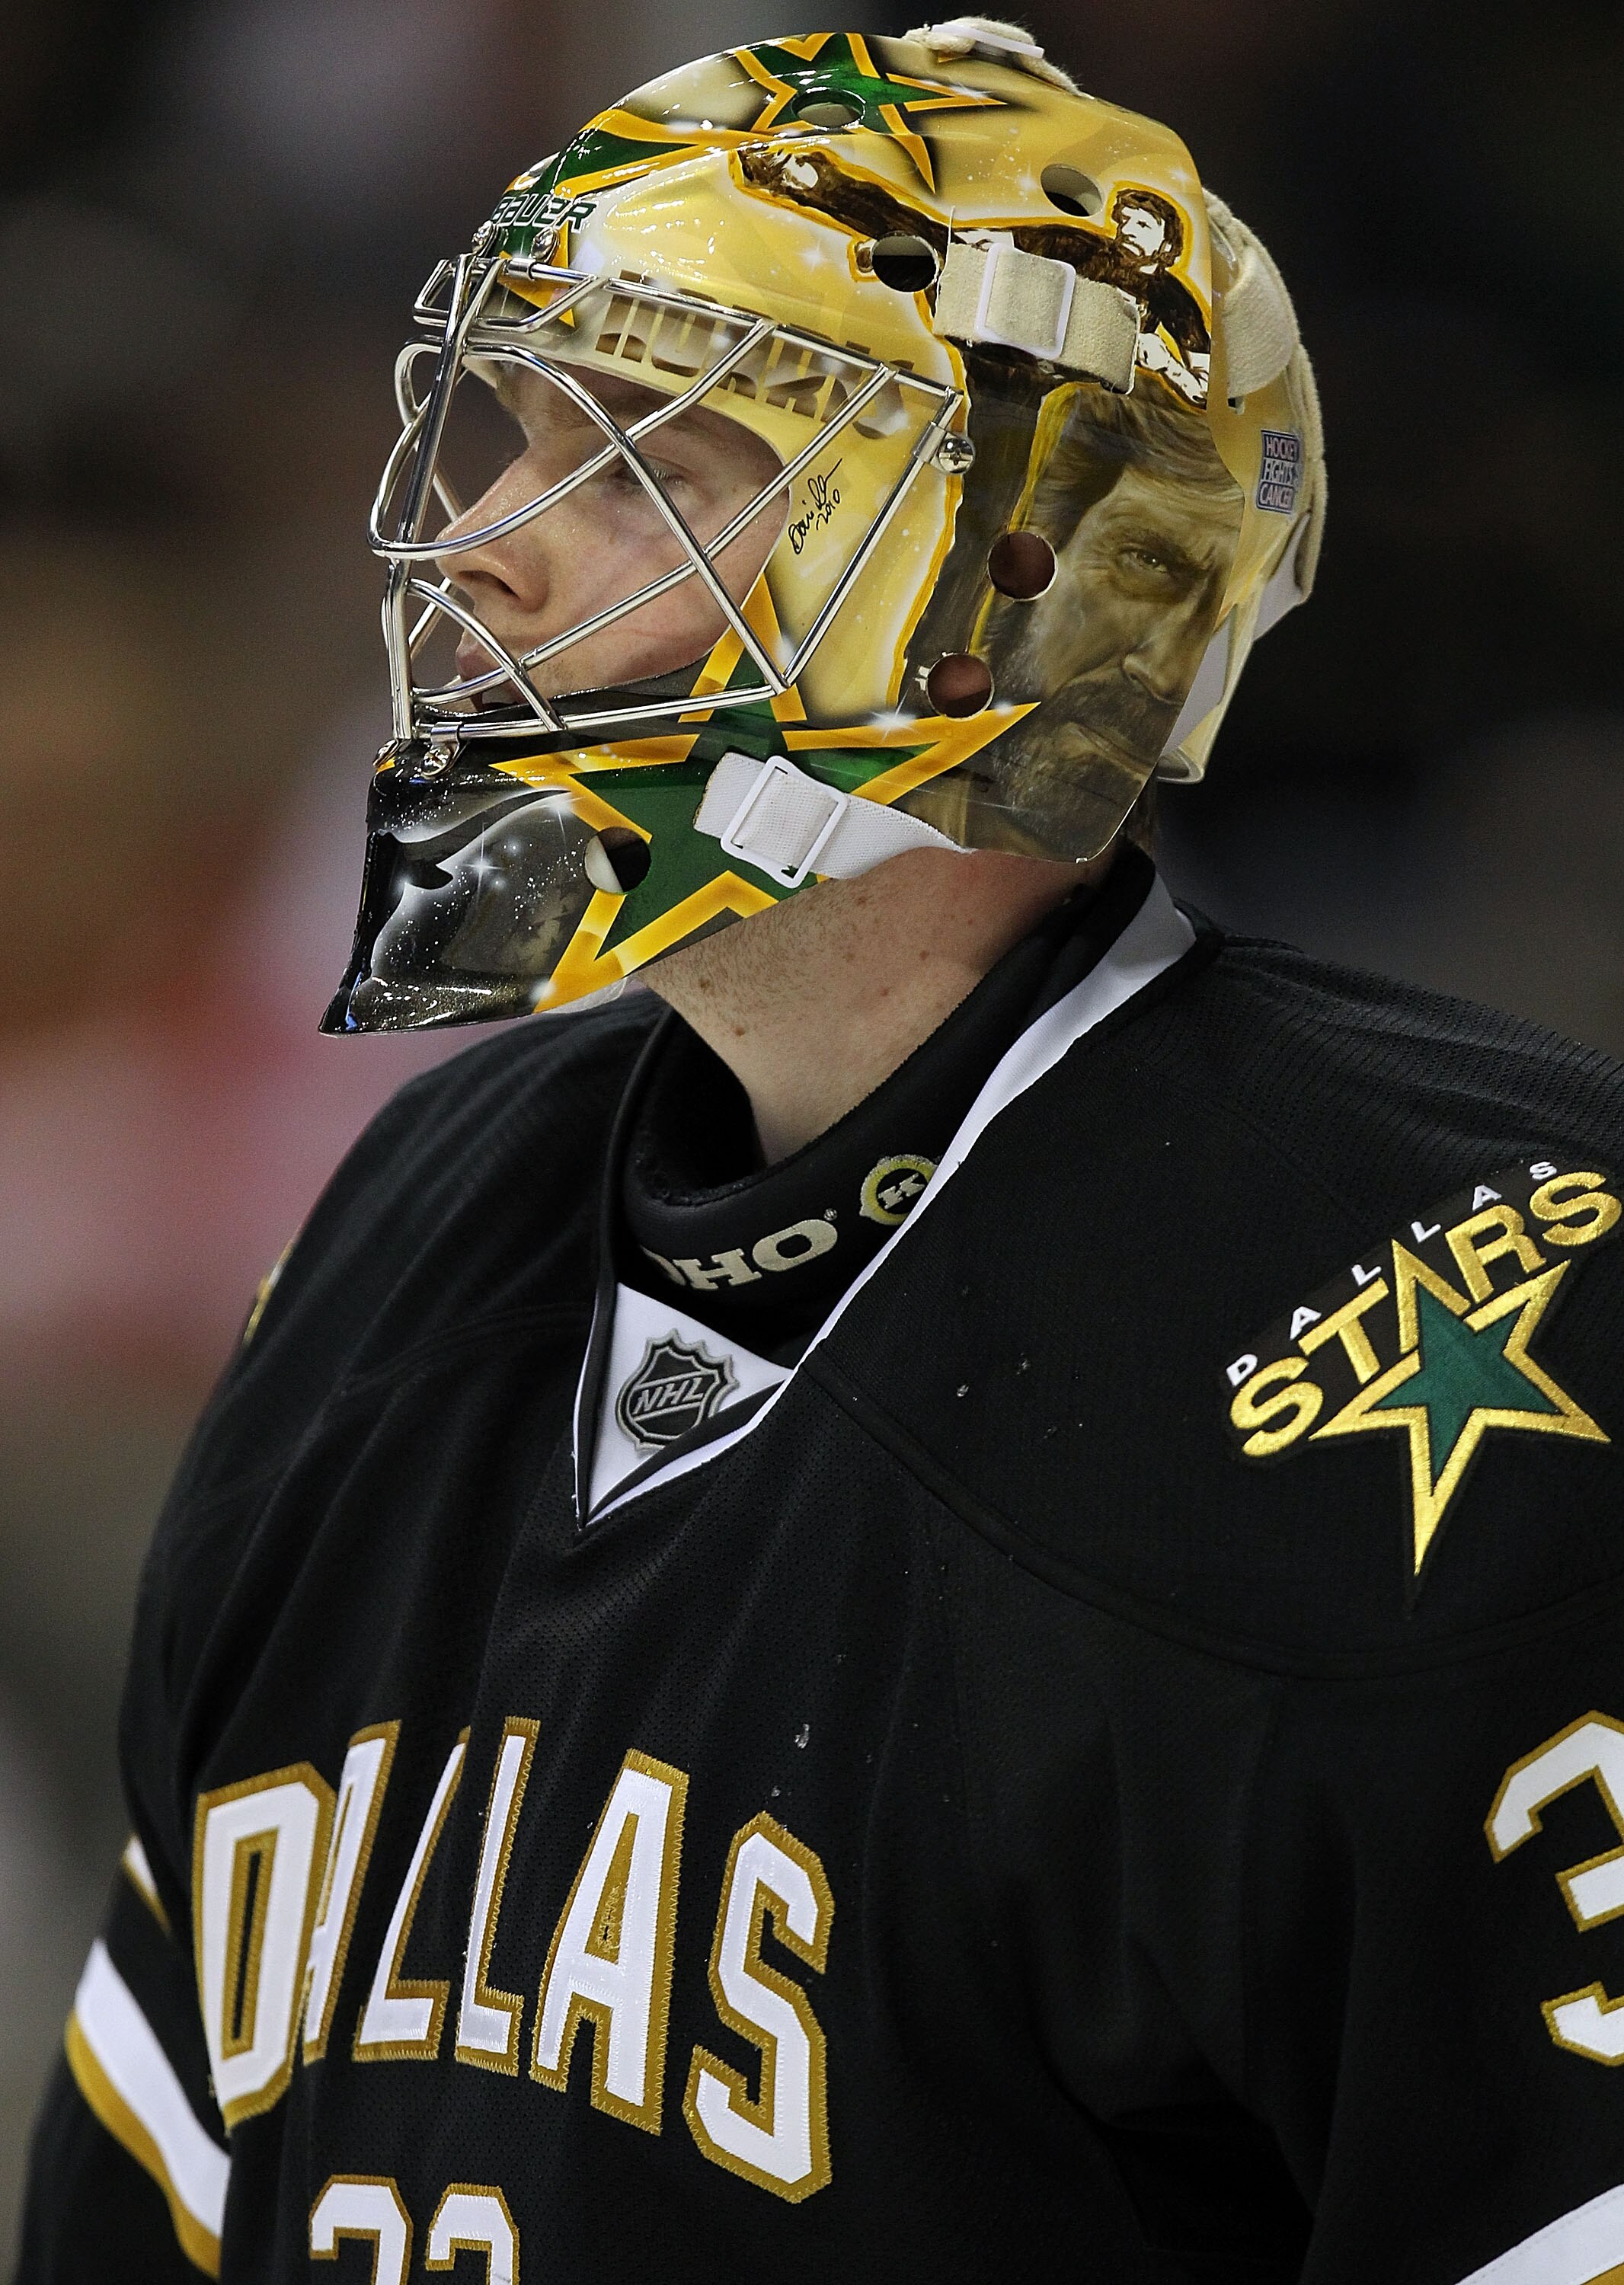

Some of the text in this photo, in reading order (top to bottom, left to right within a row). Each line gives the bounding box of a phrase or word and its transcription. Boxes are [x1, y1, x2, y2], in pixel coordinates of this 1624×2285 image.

[491, 193, 599, 234] BAUER
[640, 1219, 838, 1290] HO
[1226, 1162, 1558, 1386] DALLAS
[1230, 1171, 1622, 1458] STARS
[633, 1377, 706, 1414] NHL
[192, 1716, 835, 2204] DALLAS
